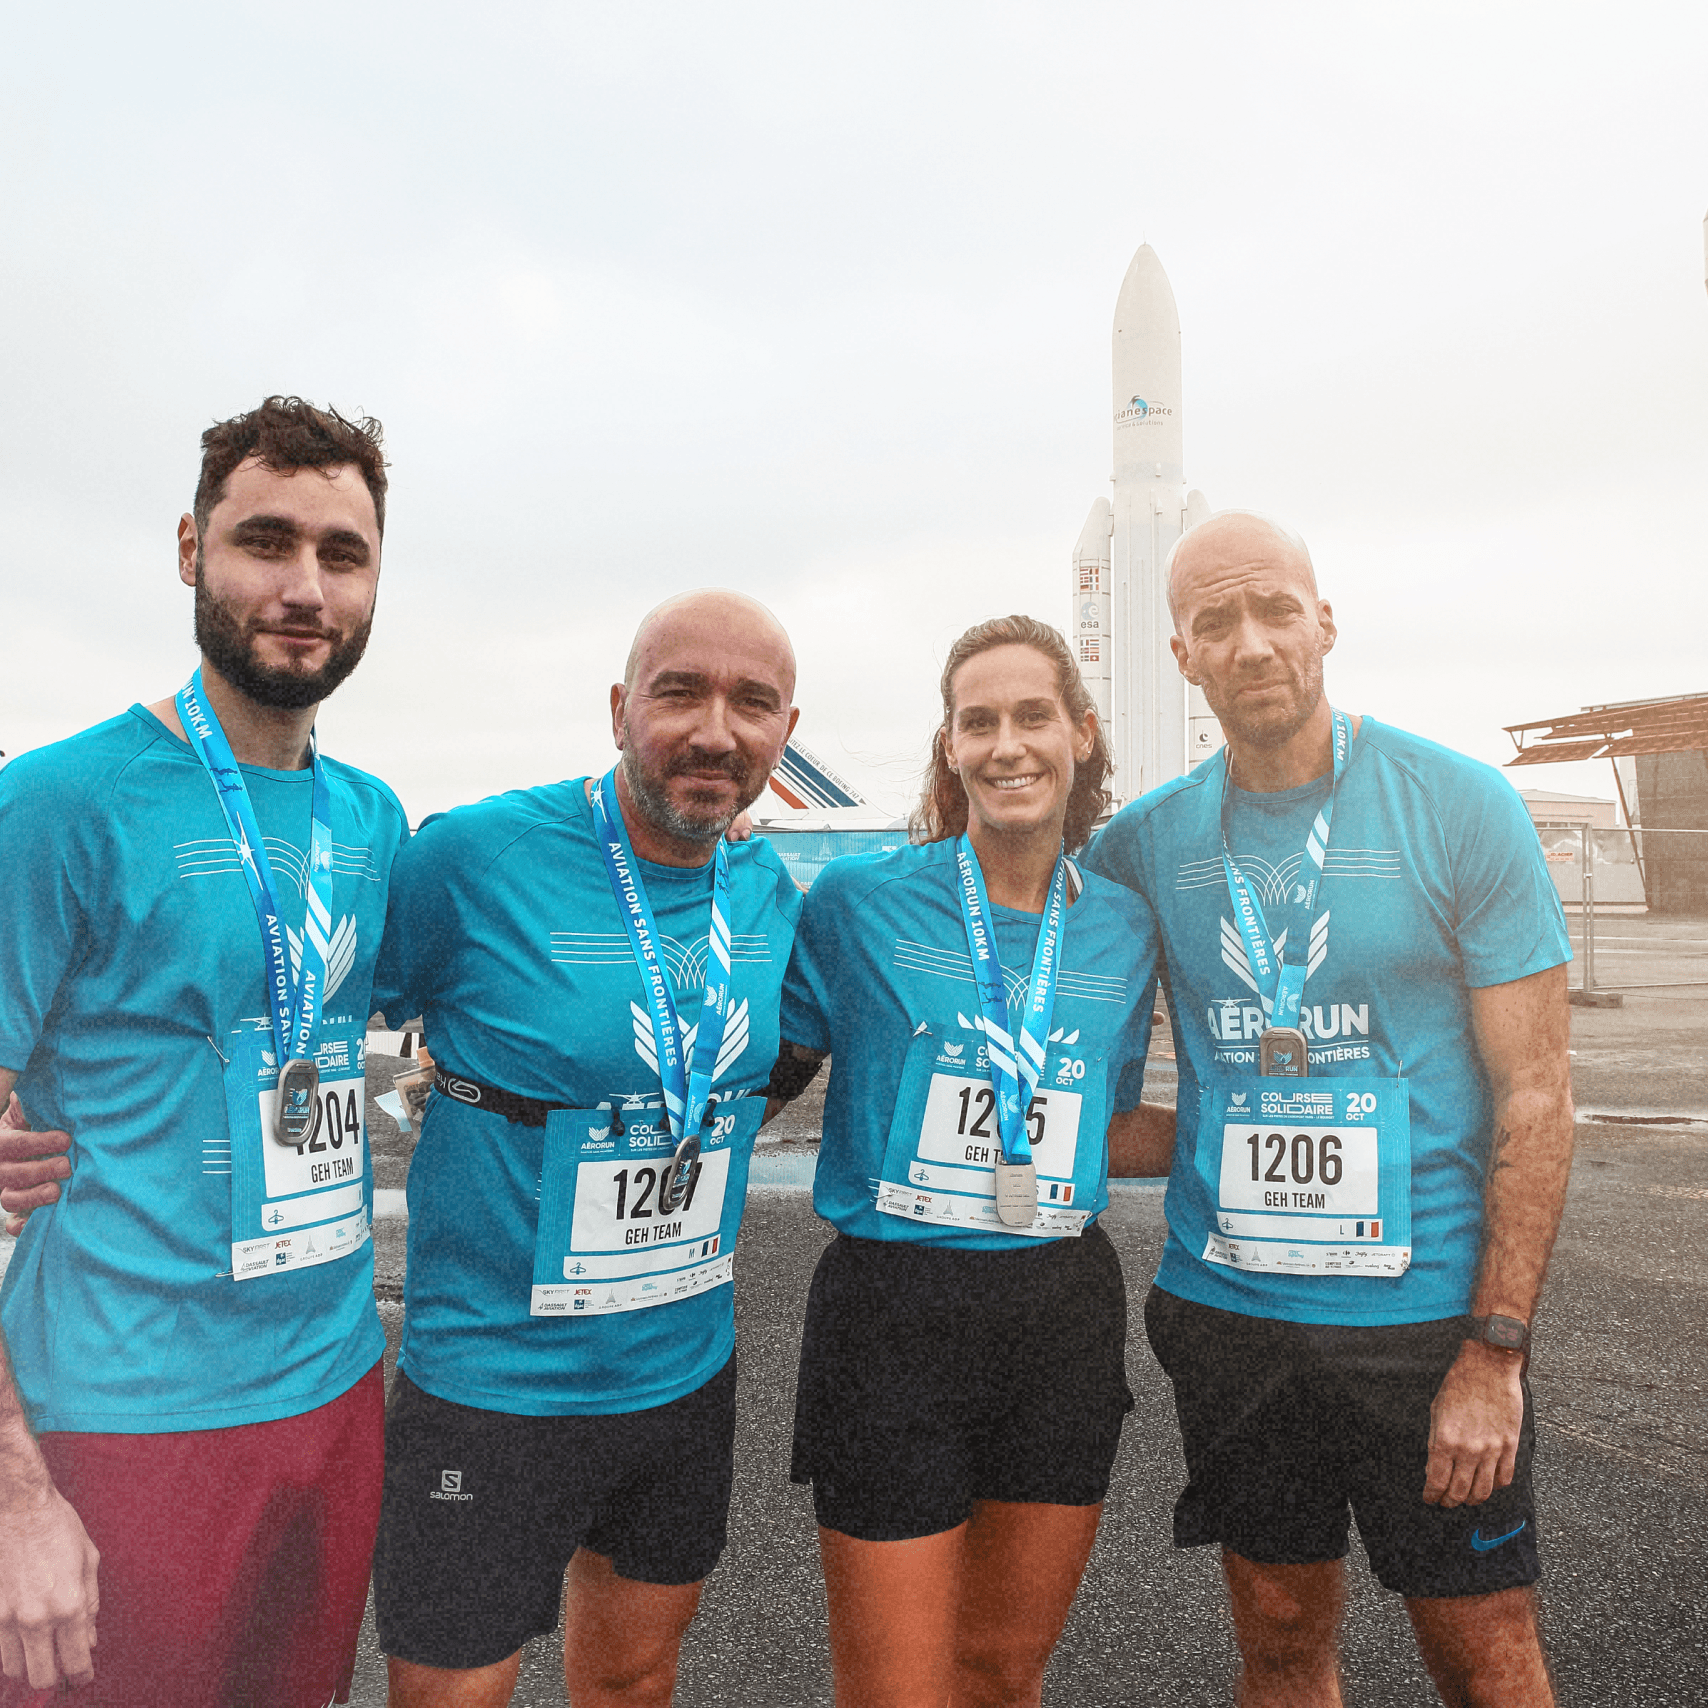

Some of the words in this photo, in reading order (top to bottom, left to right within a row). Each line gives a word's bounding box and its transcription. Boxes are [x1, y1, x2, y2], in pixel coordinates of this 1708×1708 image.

[1080, 620, 1100, 628] esa
[184, 698, 213, 740] 10KM
[1336, 724, 1346, 762] 10KM
[832, 775, 850, 792] BOEING
[849, 790, 860, 799] 747
[956, 852, 982, 917] AÉRORUN
[970, 920, 990, 961] 10KM
[1304, 880, 1315, 910] AÉRORUN
[1048, 890, 1062, 931] SANS
[1236, 888, 1270, 976] FRONTIÈRES
[265, 914, 288, 1002] AVIATION
[608, 842, 643, 915] AVIATION
[634, 918, 656, 961] SANS
[648, 965, 678, 1067] FRONTIÈRES
[1032, 929, 1057, 1014] FRONTIÈRES
[716, 982, 724, 1016] AÉRORUN
[296, 970, 316, 1054] AVIATION
[1308, 1046, 1371, 1065] ONTIÈRES
[936, 1055, 966, 1066] AÉRORUN
[1056, 1078, 1074, 1086] OCT
[1057, 1057, 1086, 1080] 20
[1260, 1092, 1333, 1104] COURSE
[1346, 1092, 1377, 1113] 20
[1260, 1104, 1334, 1115] SOLIDAIRE
[1346, 1112, 1365, 1121] OCT
[711, 1114, 736, 1137] 20
[580, 1142, 615, 1150] AÉRORUN
[710, 1135, 726, 1146] OCT
[964, 1145, 989, 1162] GEH
[1246, 1132, 1342, 1186] 1206
[310, 1162, 331, 1184] GEH
[332, 1156, 354, 1178] TEAM
[916, 1194, 932, 1203] JETEX
[1264, 1190, 1288, 1208] GEH
[1292, 1192, 1326, 1209] TEAM
[625, 1228, 649, 1245] GEH
[652, 1222, 682, 1242] TEAM
[1339, 1224, 1344, 1235] L
[274, 1239, 292, 1250] JETEX
[688, 1248, 696, 1259] M
[430, 1491, 474, 1500] salomon
